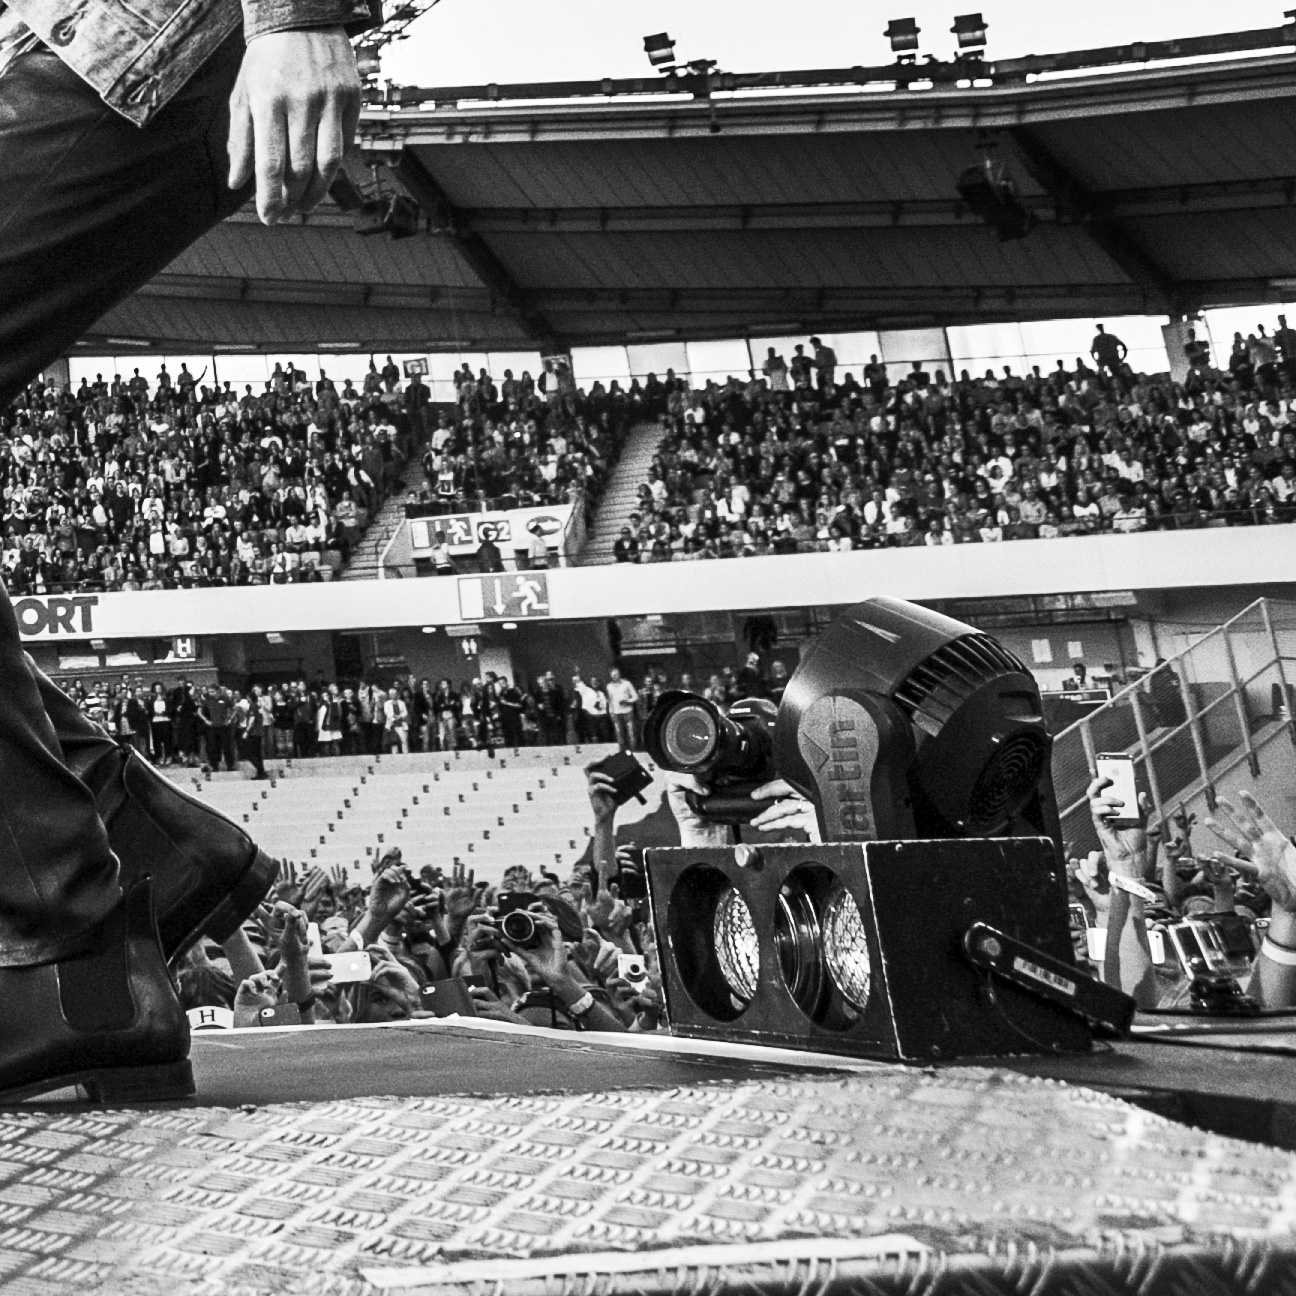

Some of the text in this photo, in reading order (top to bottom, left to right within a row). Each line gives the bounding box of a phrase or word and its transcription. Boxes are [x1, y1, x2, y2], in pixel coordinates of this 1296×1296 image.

[478, 522, 511, 541] G2
[13, 595, 99, 635] ORT
[199, 1008, 216, 1024] H
